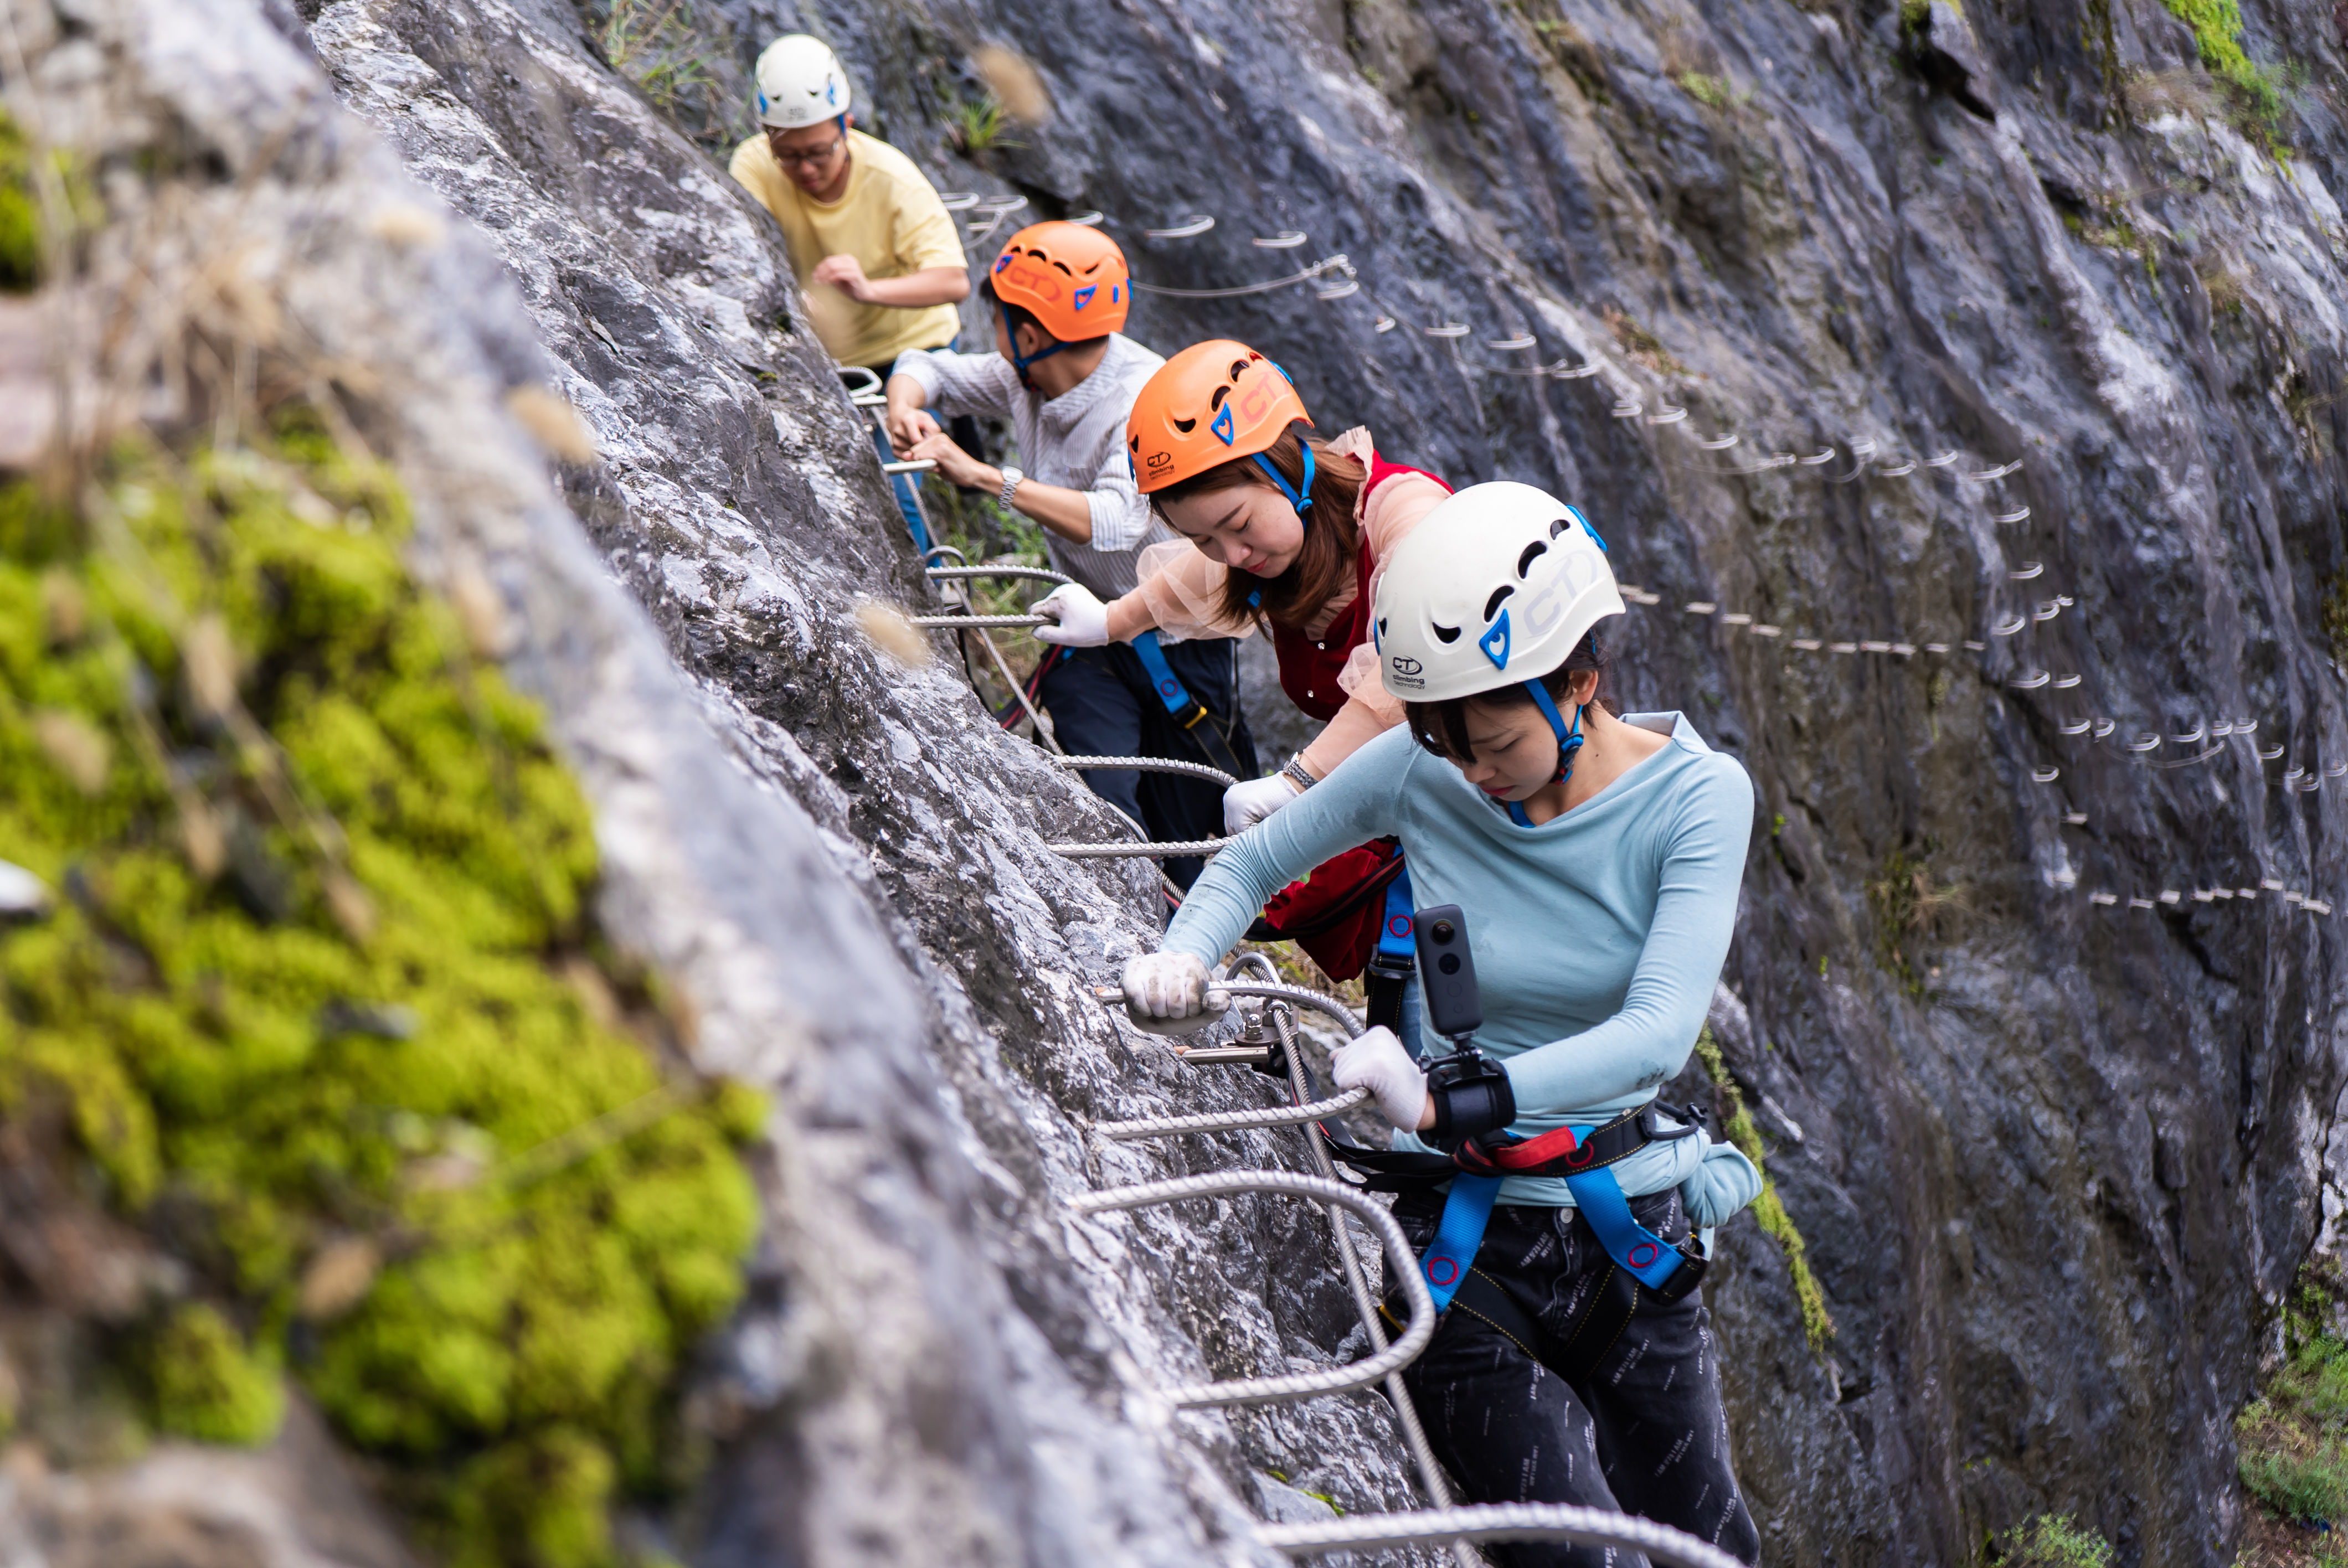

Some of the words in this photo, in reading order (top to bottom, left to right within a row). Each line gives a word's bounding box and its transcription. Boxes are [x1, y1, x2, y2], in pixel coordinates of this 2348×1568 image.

[1010, 266, 1050, 290] CT
[1241, 373, 1278, 423] CT
[1523, 556, 1578, 636] CT
[1393, 674, 1425, 685] climbing
